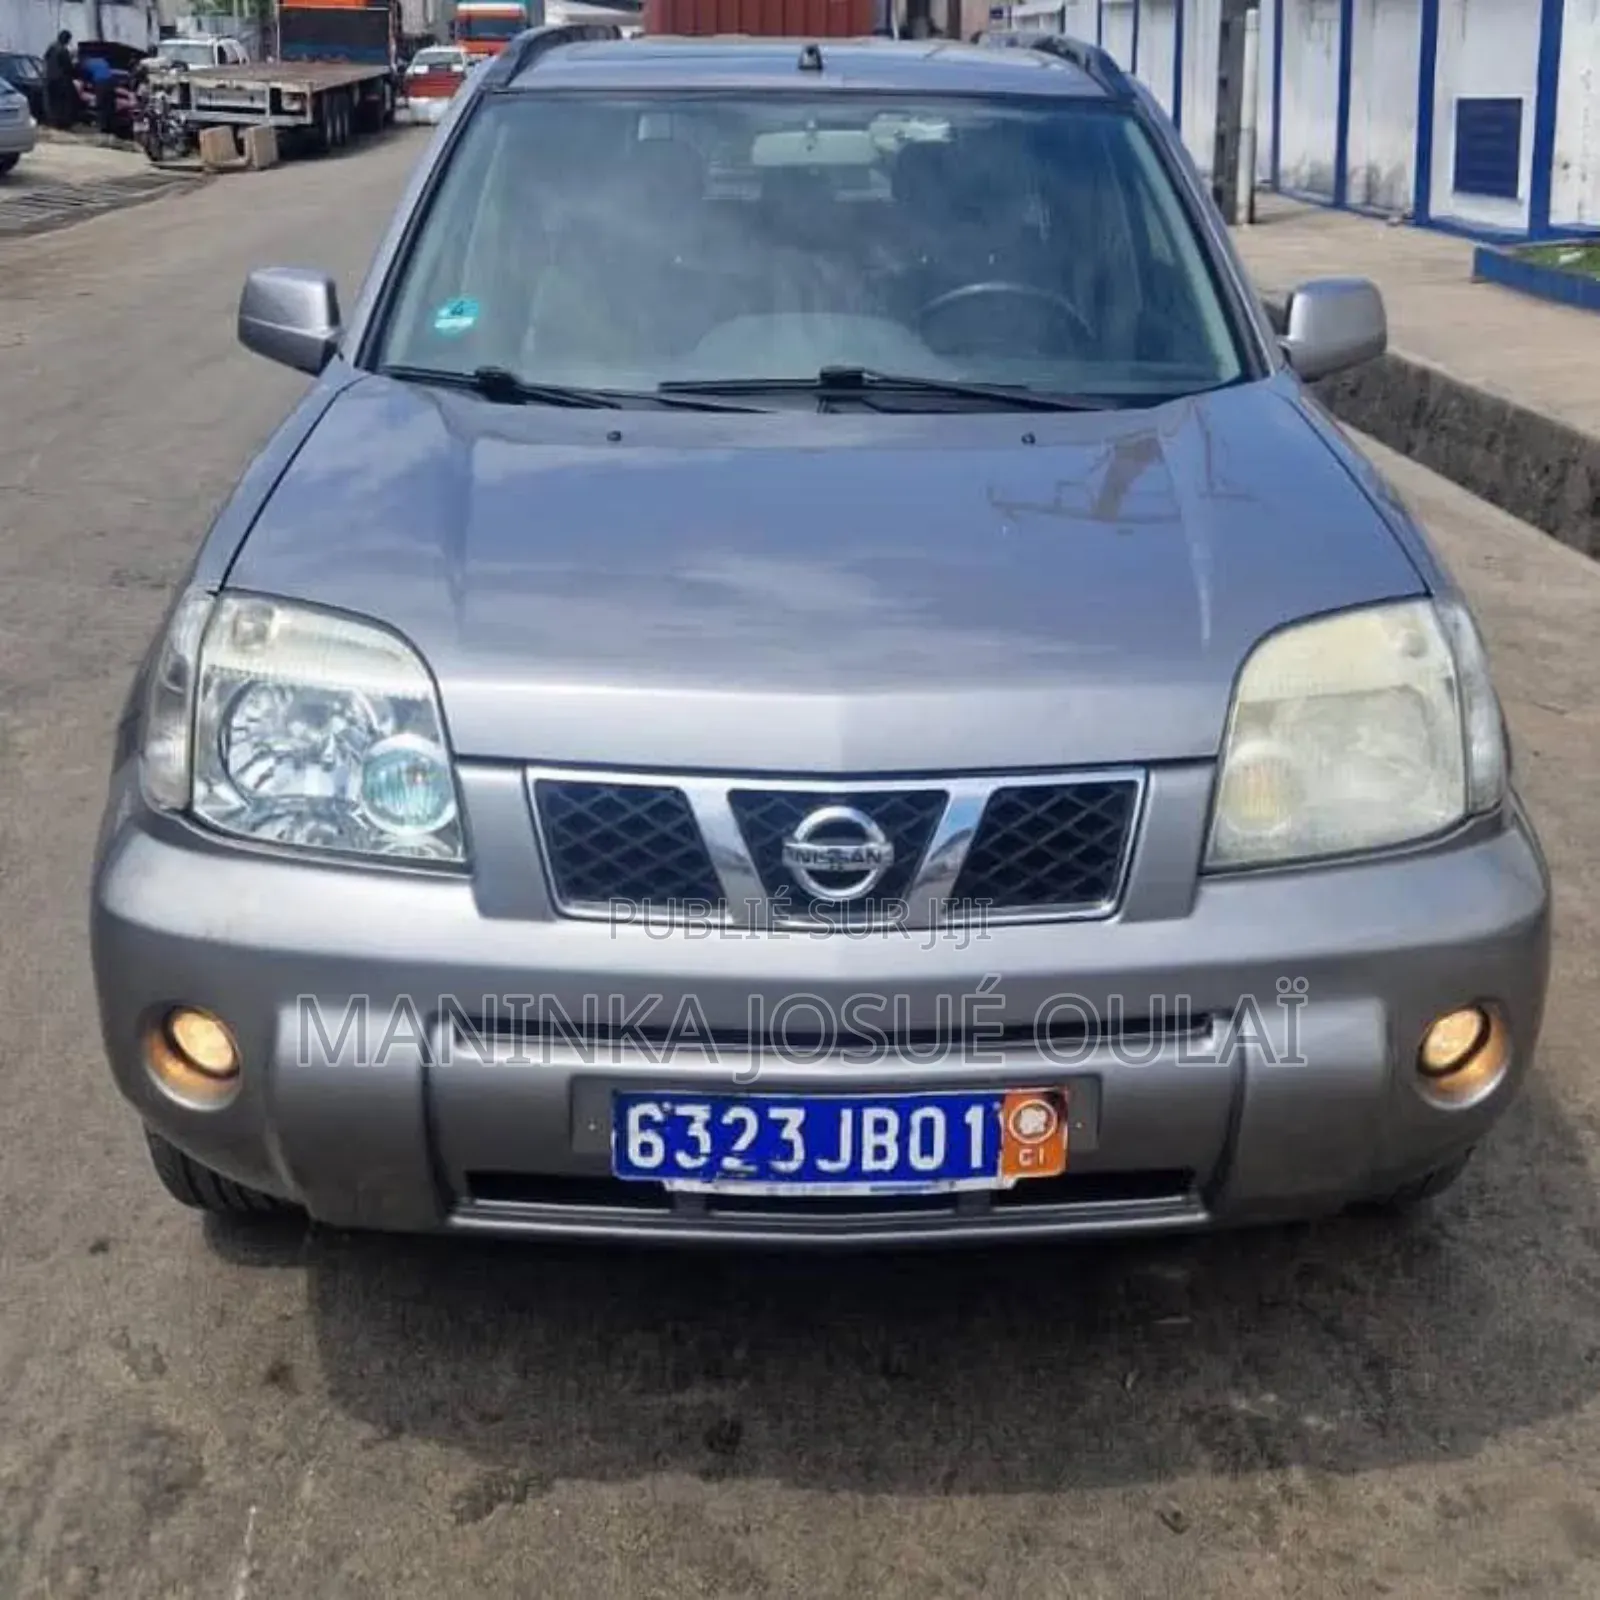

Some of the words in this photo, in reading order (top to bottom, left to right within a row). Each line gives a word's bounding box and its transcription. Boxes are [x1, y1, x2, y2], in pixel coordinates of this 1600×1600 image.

[794, 847, 882, 864] NISSAN
[626, 1102, 985, 1172] 6323JB01
[1019, 1147, 1045, 1166] CI
